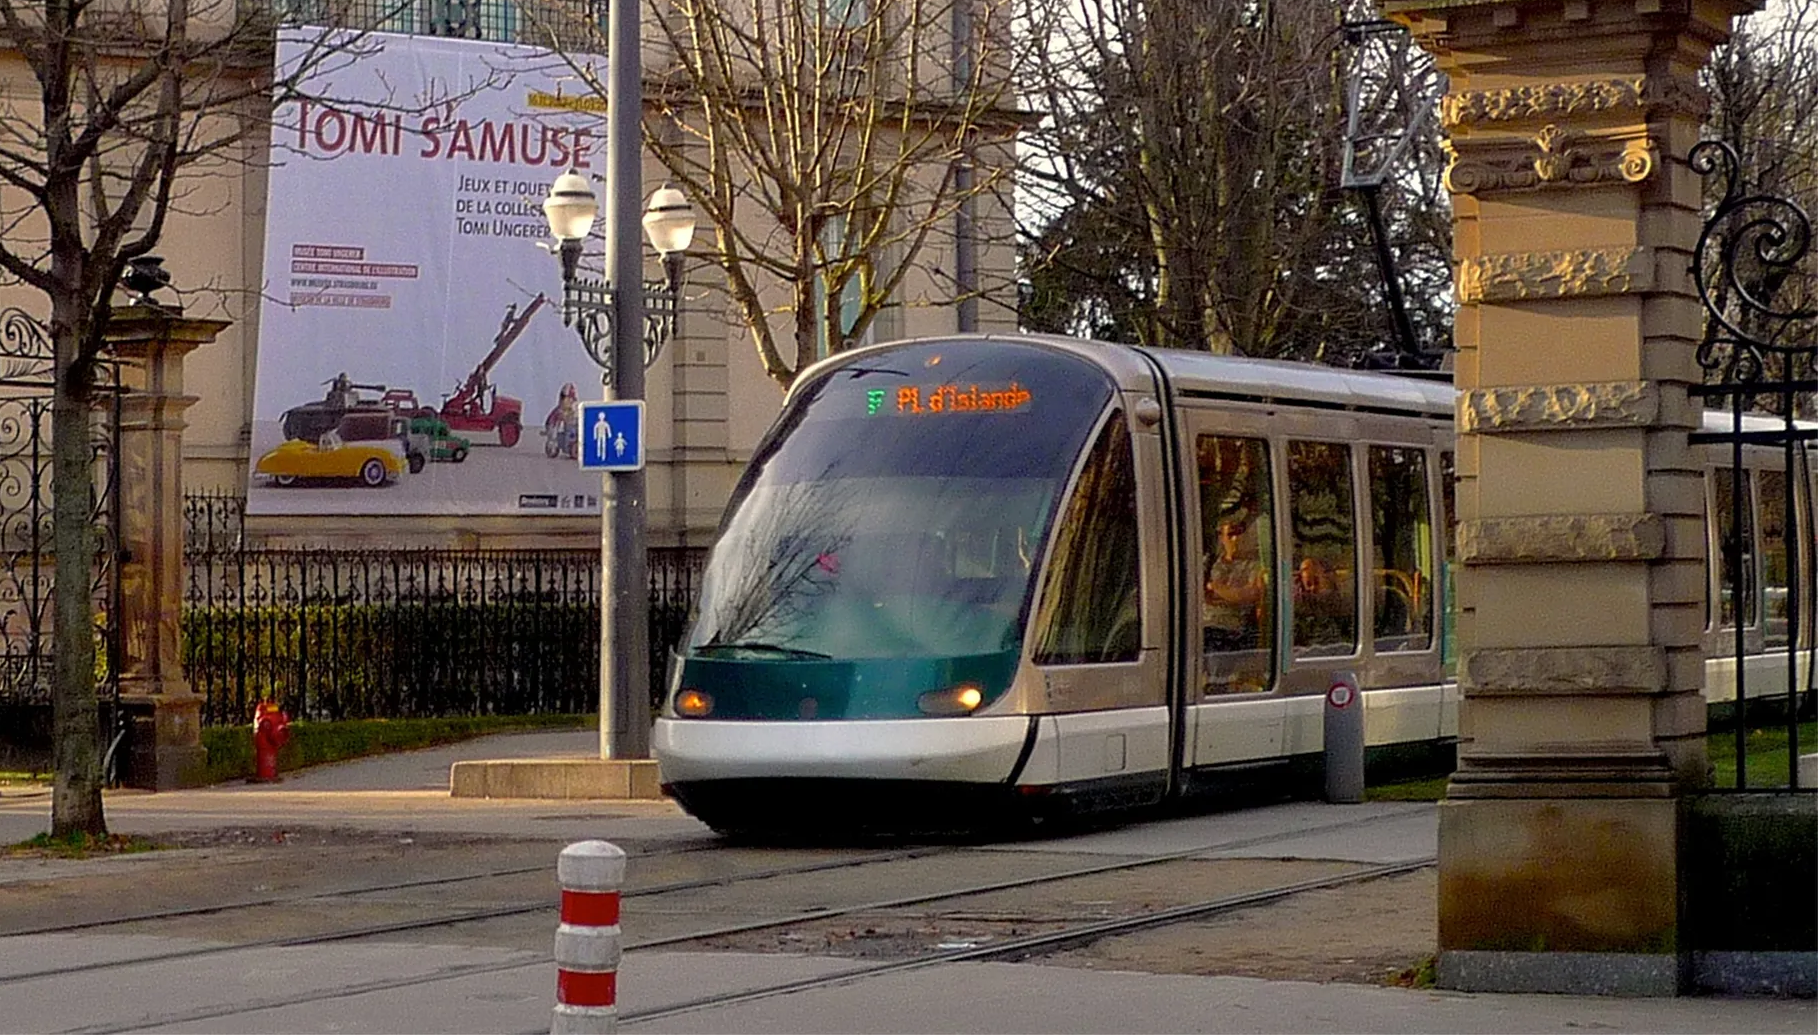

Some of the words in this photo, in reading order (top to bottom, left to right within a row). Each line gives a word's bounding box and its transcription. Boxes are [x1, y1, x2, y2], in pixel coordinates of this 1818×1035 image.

[295, 98, 402, 156] TOMI
[420, 105, 592, 168] S'AMUSE
[457, 175, 490, 193] JEUX
[494, 180, 509, 194] ET
[511, 181, 553, 197] JOUET
[456, 199, 473, 213] DE
[476, 200, 492, 215] LA
[456, 217, 489, 235] TOMI
[492, 219, 552, 239] UNGERER
[867, 389, 885, 415] F
